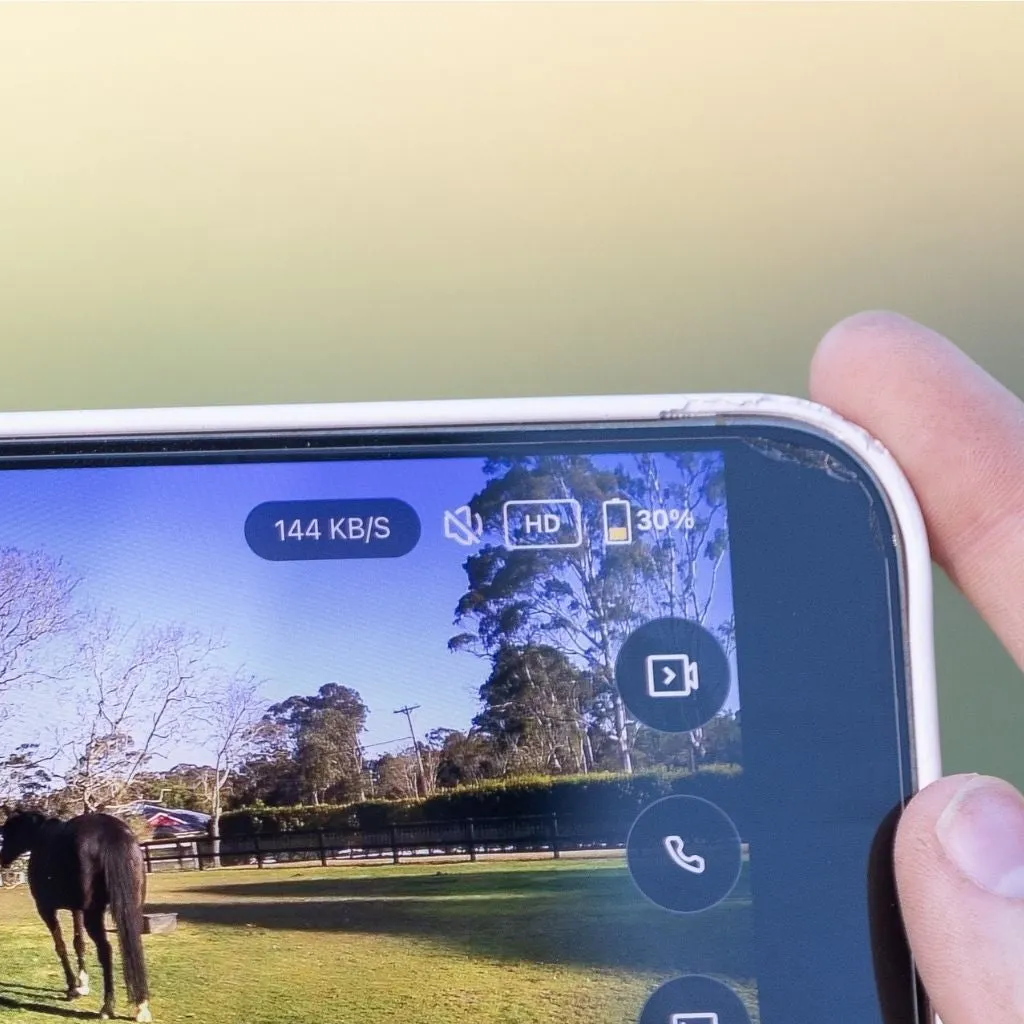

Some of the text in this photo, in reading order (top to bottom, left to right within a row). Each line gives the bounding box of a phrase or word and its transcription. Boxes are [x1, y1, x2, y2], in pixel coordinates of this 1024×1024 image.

[275, 516, 391, 543] 144 KB/S
[525, 514, 561, 533] HD
[636, 508, 694, 532] 30%
